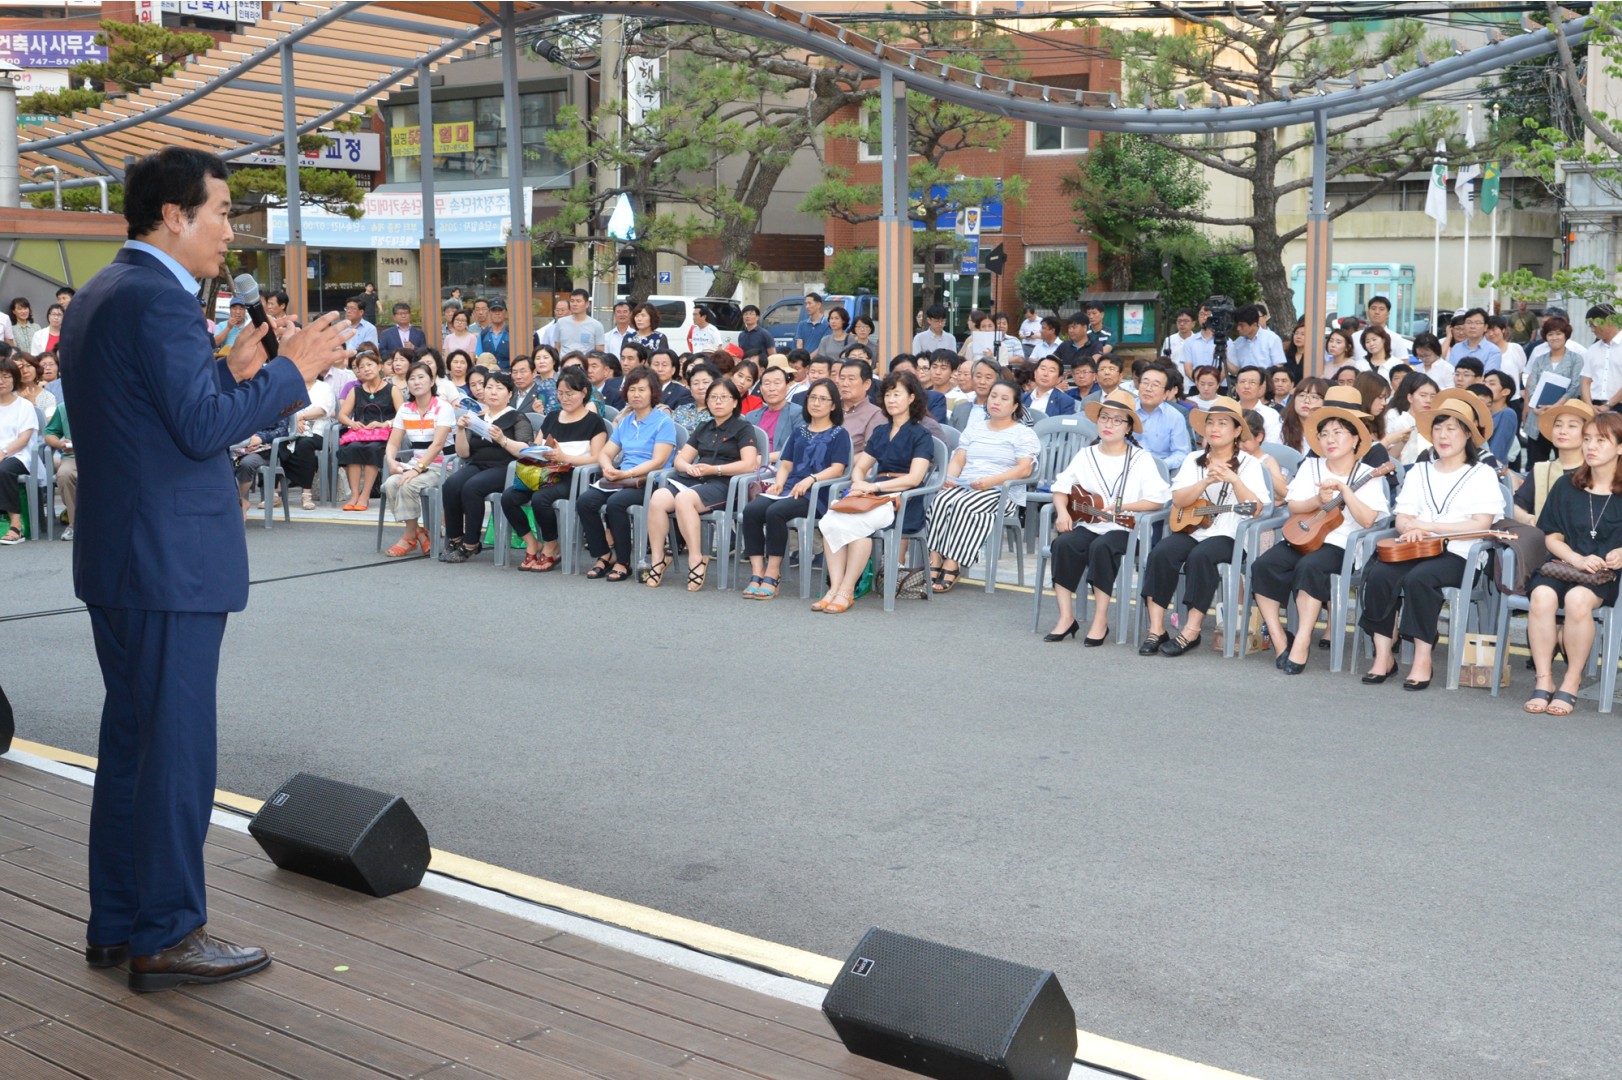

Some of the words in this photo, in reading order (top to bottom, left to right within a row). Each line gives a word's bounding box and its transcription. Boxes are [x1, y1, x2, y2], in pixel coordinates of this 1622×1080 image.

[0, 34, 101, 55] 건축사사무소
[325, 138, 361, 162] 교정
[252, 157, 315, 166] 742-40
